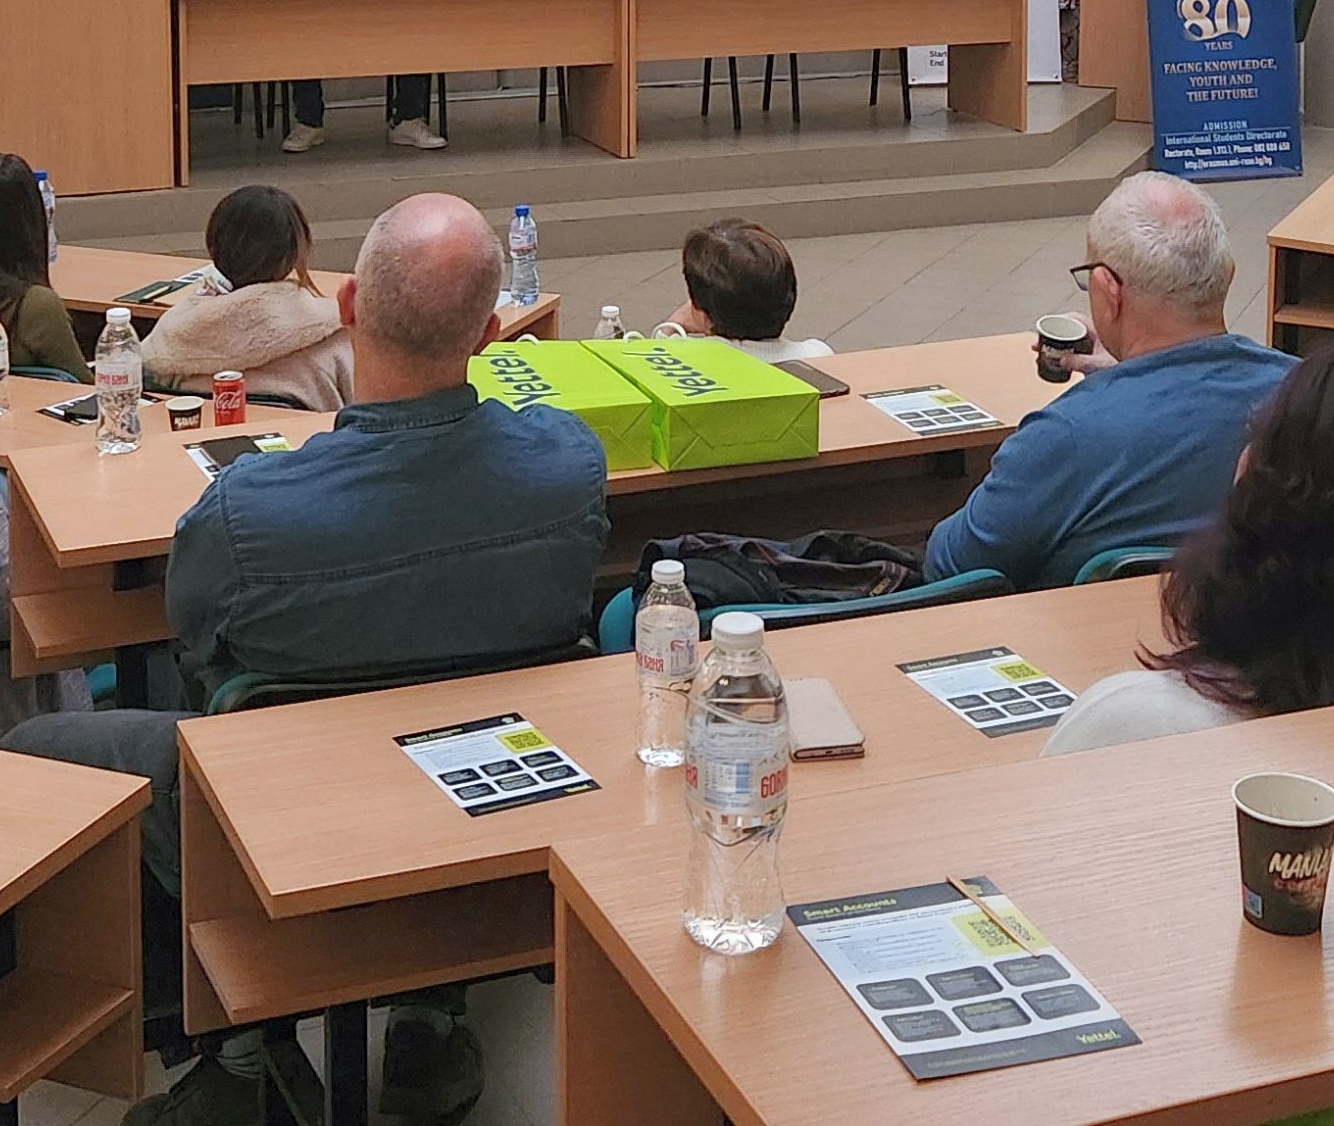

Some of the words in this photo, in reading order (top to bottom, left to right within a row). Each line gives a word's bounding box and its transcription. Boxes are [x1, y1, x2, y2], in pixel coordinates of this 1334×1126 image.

[1204, 41, 1234, 51] YEARS
[1164, 62, 1203, 74] FACING
[1204, 58, 1278, 72] KNOWLEDGE,
[1189, 75, 1228, 88] YOUTH
[1229, 74, 1253, 85] AND
[1187, 91, 1209, 102] THE
[1211, 88, 1259, 100] FUTURE!
[1203, 120, 1248, 131] ADMISSION
[1165, 134, 1212, 145] International
[1213, 132, 1245, 143] Students
[1246, 130, 1287, 140] Directorate
[622, 347, 729, 397] Yettel.
